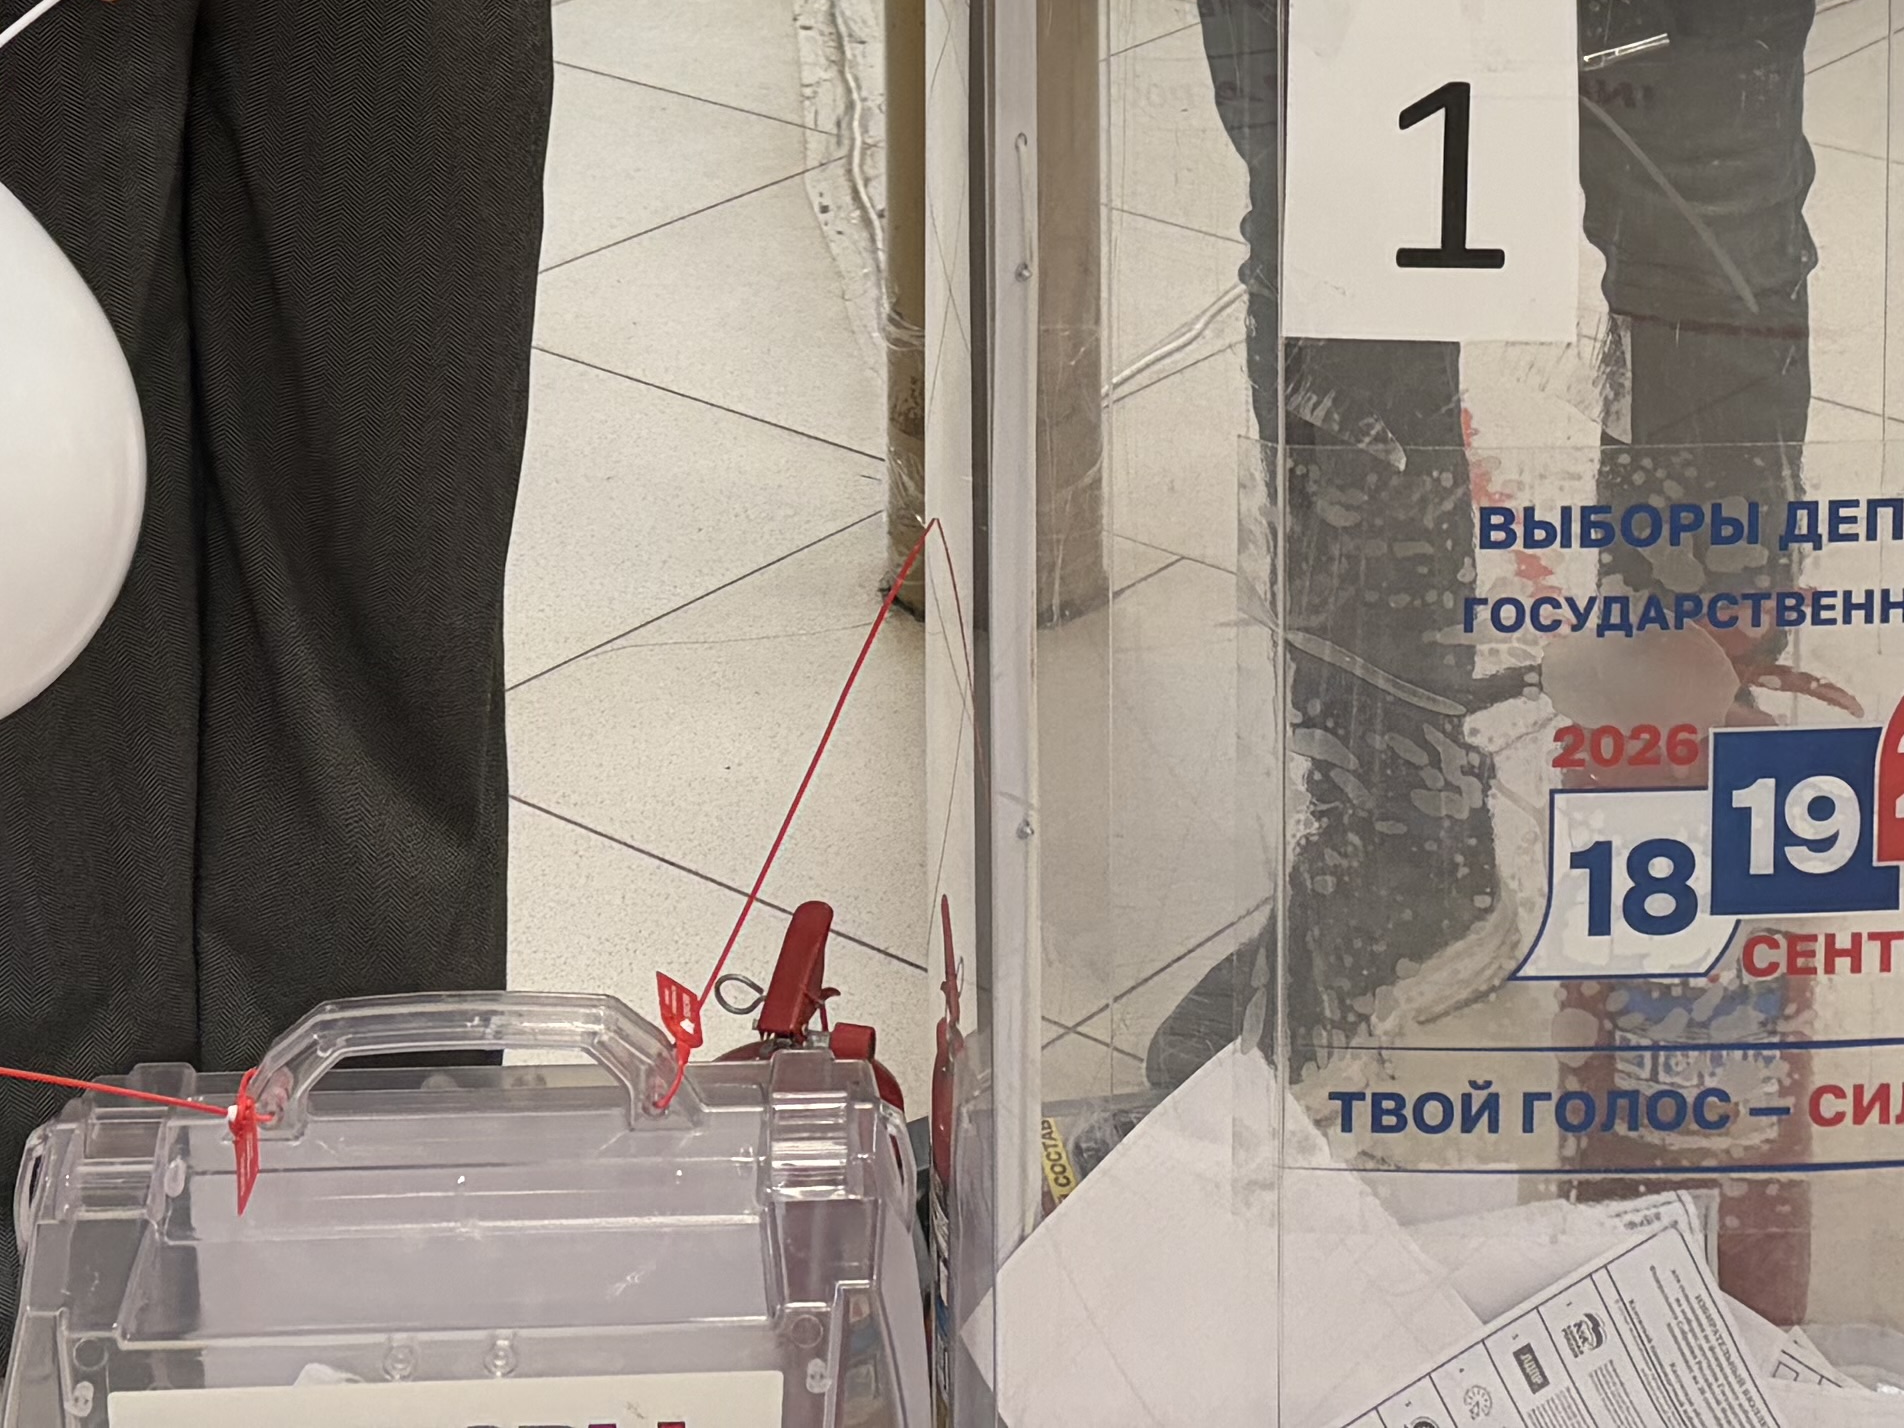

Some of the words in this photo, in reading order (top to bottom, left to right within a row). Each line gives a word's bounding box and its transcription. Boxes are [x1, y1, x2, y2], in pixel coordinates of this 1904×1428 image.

[1396, 81, 1505, 269] 1
[1479, 502, 1762, 550] ВЫБОРЫ
[1552, 723, 1698, 768] 2026
[1569, 839, 1699, 936] 18
[1732, 775, 1861, 875] 19
[1329, 1079, 1499, 1135] ТВОЙ
[1521, 1088, 1730, 1133] ГОЛОС
